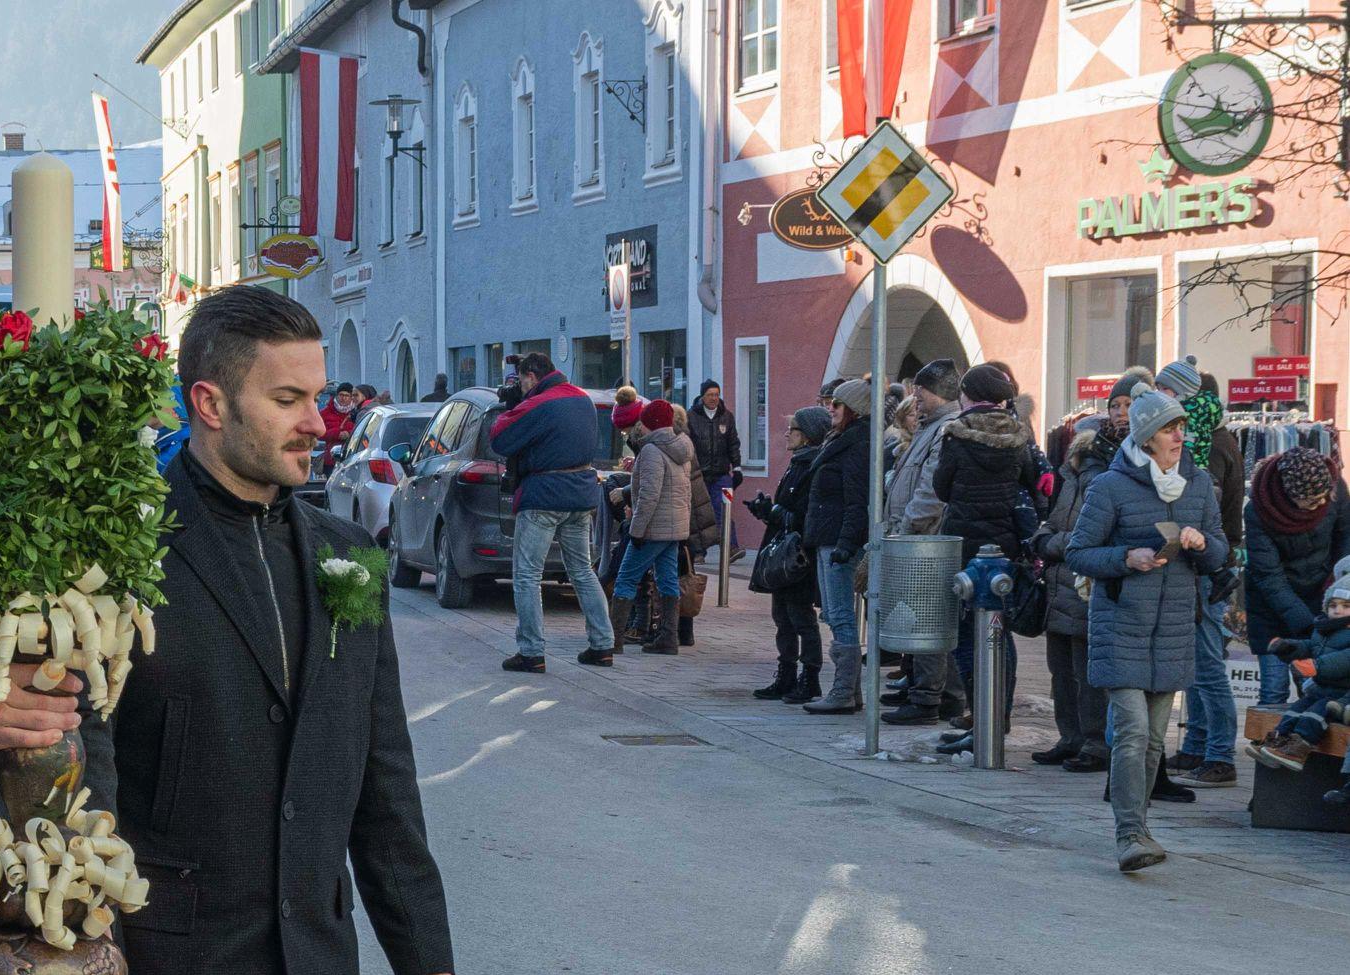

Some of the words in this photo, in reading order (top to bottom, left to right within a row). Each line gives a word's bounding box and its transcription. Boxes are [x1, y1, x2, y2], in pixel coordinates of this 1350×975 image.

[1077, 176, 1260, 240] PALMERS
[788, 225, 813, 236] Wild
[815, 225, 825, 236] &
[1081, 385, 1098, 393] SALE
